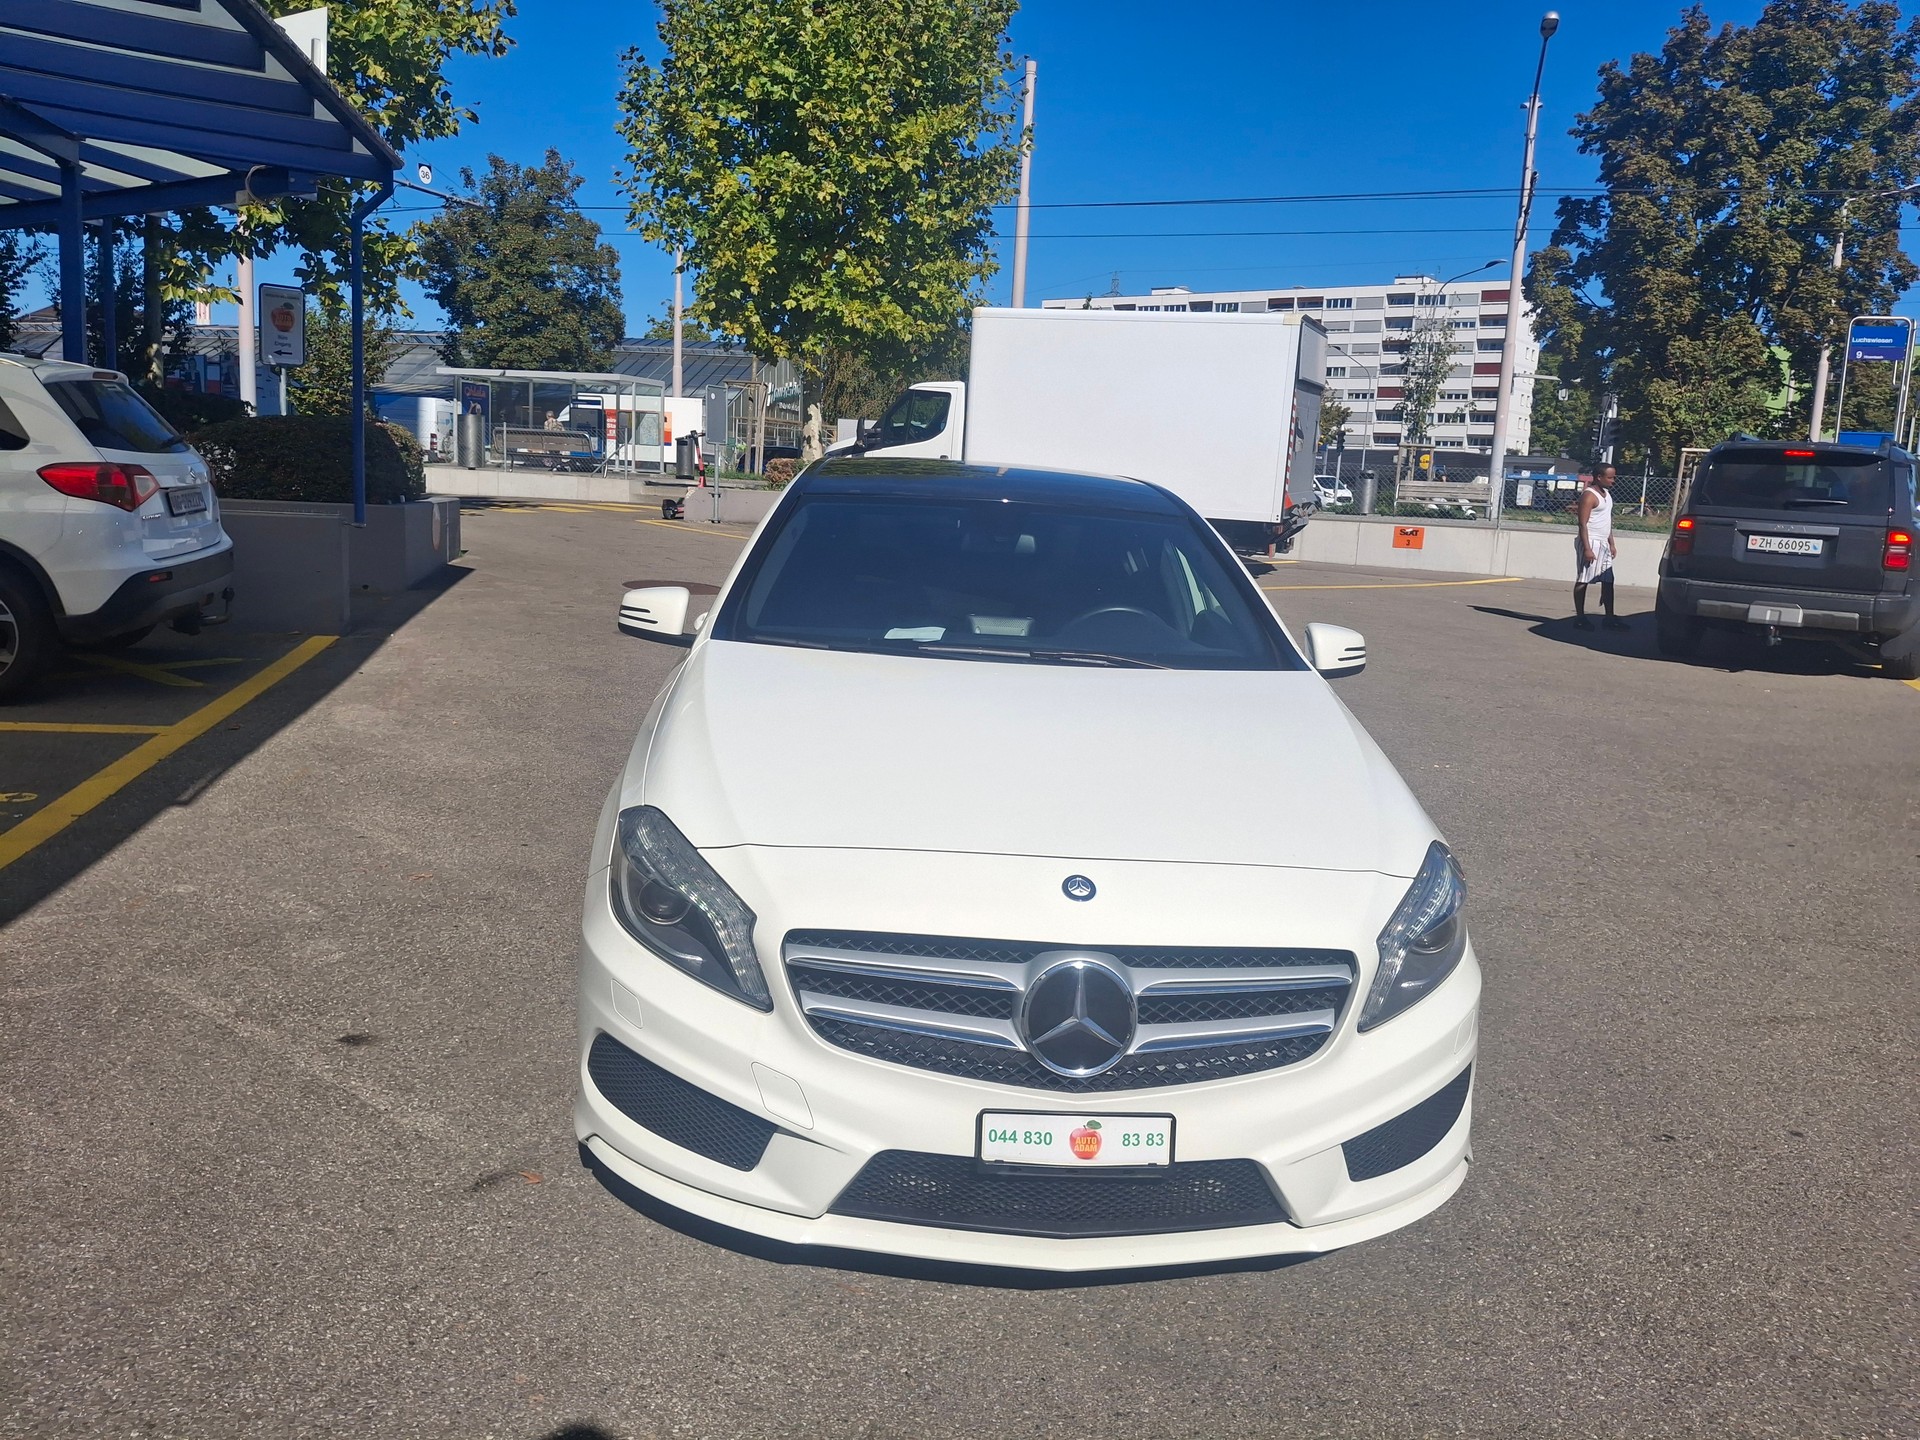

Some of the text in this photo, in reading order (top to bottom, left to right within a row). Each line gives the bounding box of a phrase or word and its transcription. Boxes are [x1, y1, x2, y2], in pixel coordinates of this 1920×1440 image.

[420, 170, 431, 180] 36
[1856, 350, 1863, 359] 9
[1758, 537, 1811, 552] ZH 66095
[988, 1129, 1165, 1147] 044 830 83 83
[1075, 1136, 1097, 1145] AUTO
[1074, 1144, 1098, 1152] ADAM
